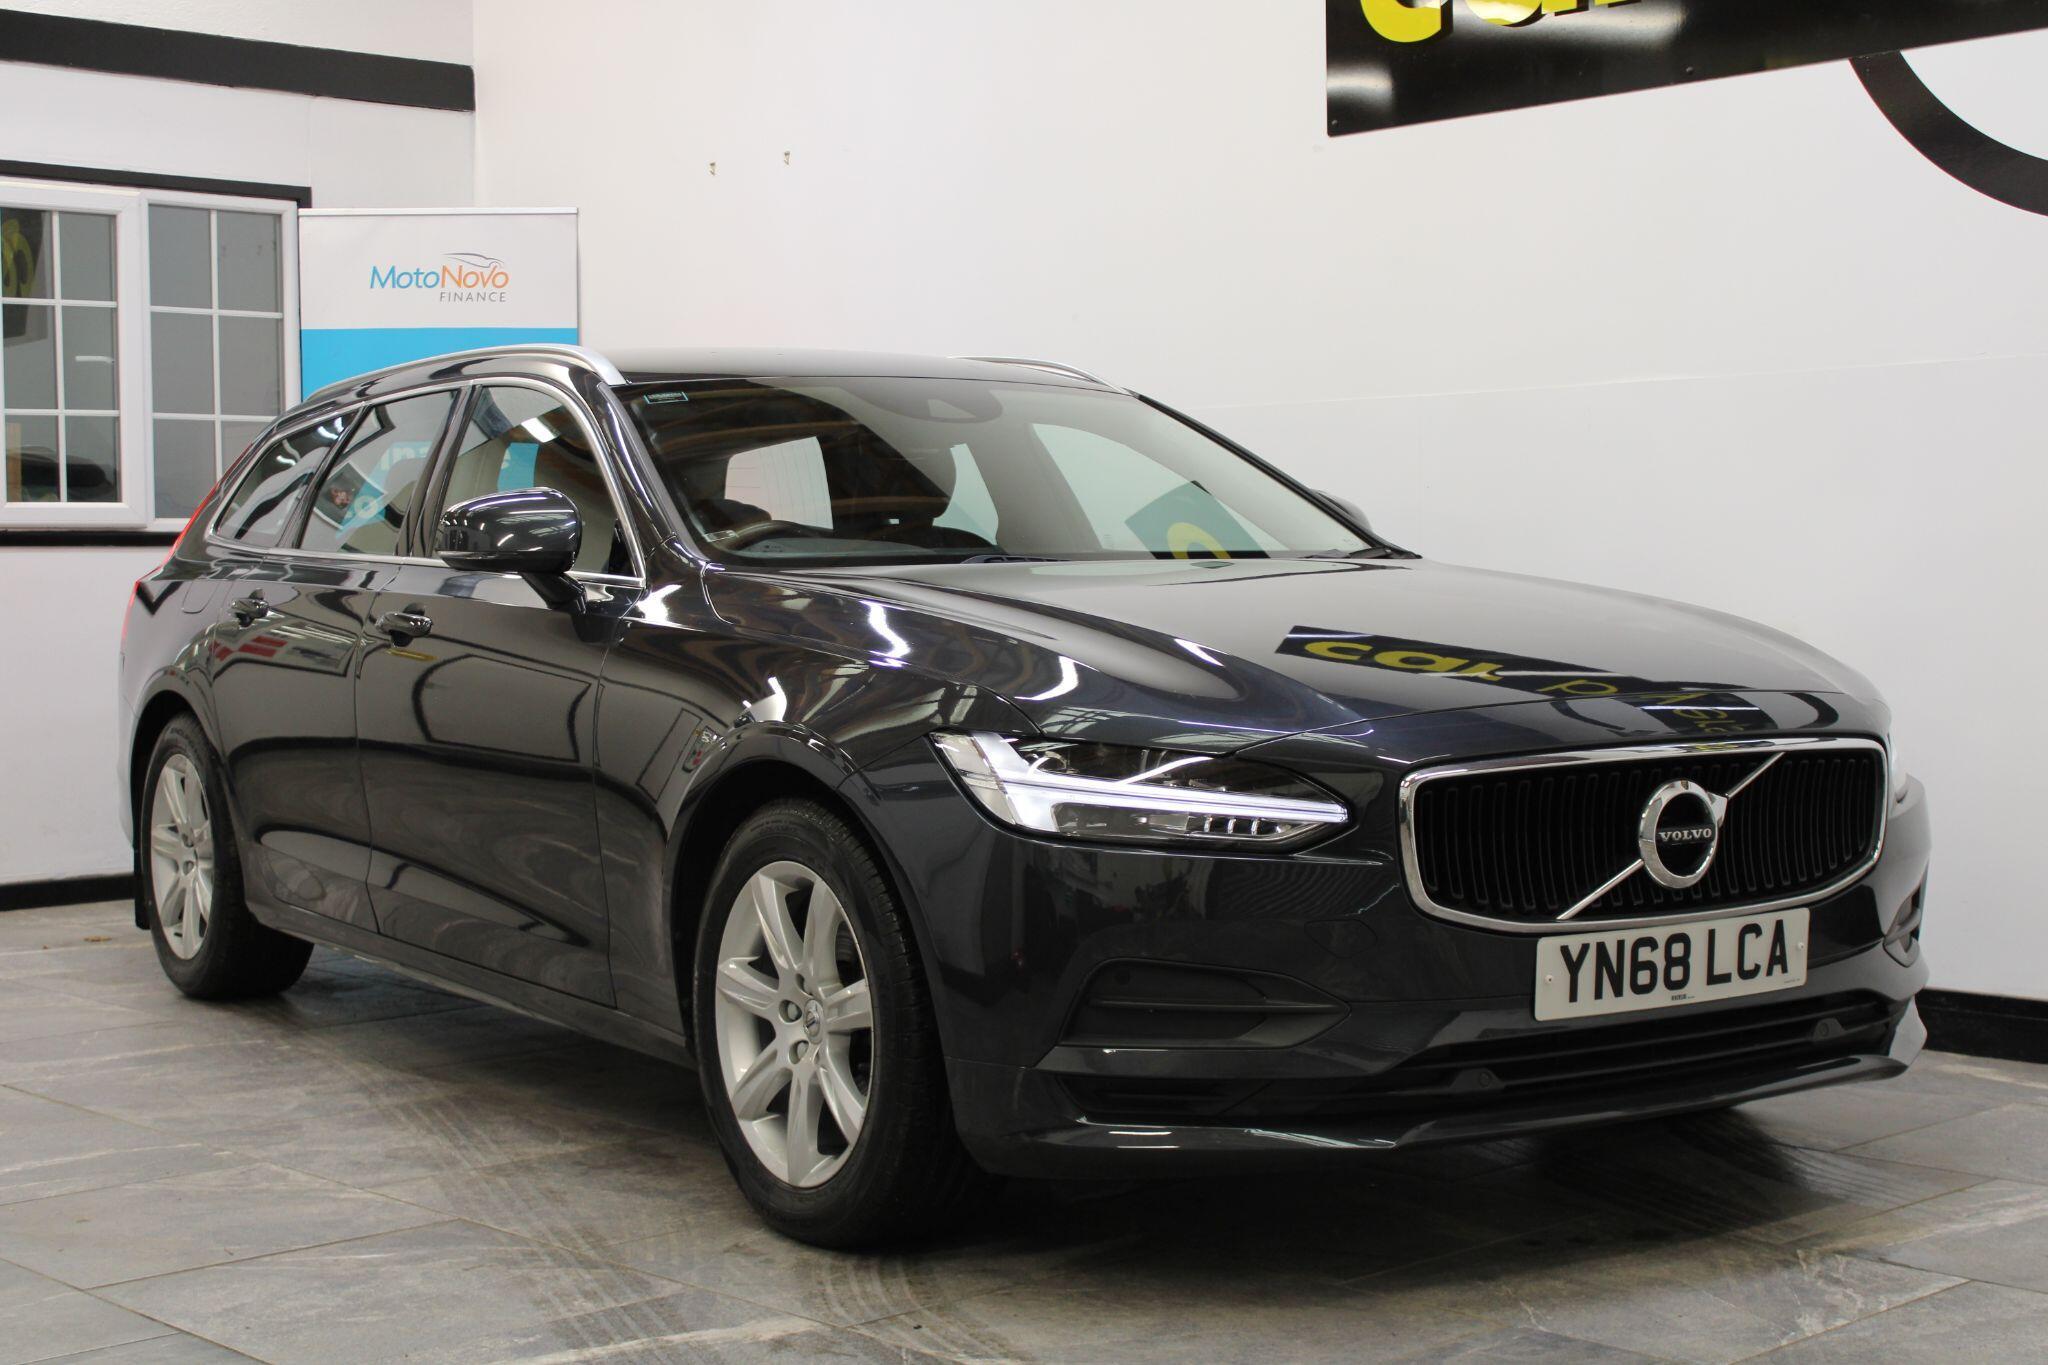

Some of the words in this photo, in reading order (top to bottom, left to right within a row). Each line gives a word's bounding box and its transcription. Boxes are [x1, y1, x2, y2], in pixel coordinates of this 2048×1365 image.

[369, 264, 510, 290] MotoNovo
[439, 291, 507, 303] FINANCE
[1658, 827, 1713, 842] VOLVO
[1560, 932, 1692, 1003] YN68
[1706, 918, 1789, 986] LCA
